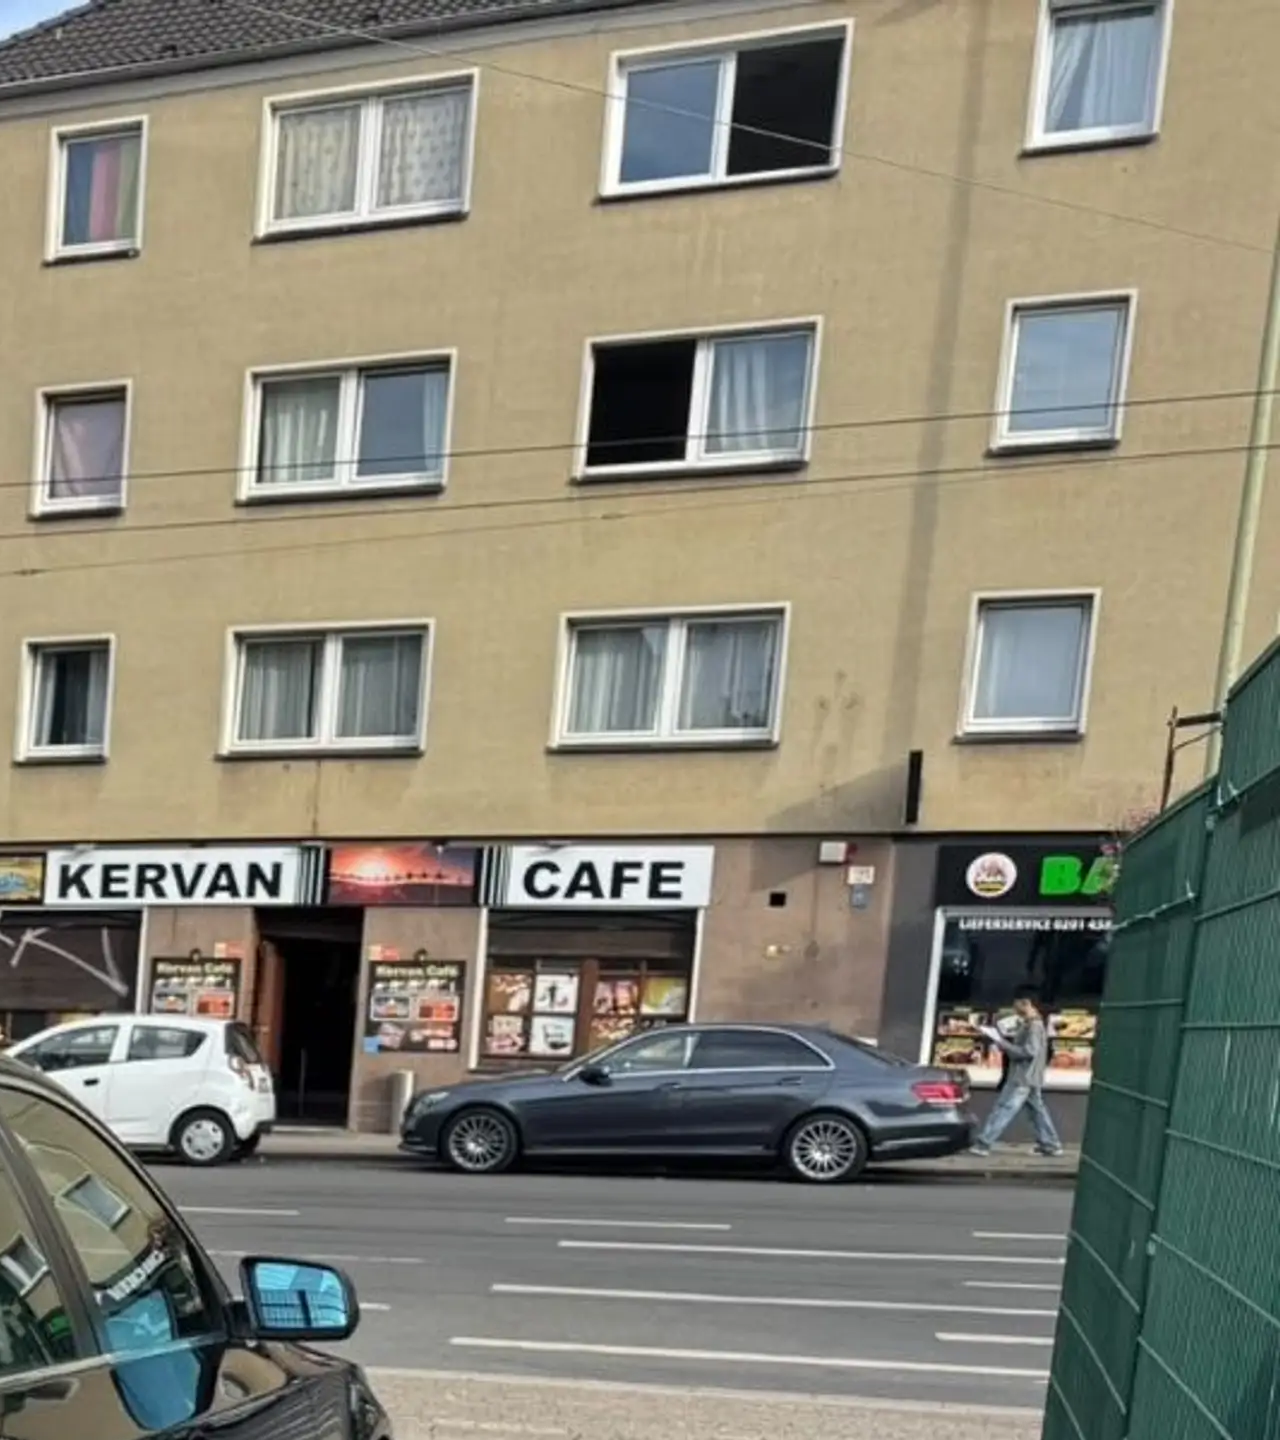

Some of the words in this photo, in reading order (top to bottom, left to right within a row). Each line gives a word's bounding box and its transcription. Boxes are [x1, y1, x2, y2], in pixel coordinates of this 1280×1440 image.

[58, 862, 282, 899] KERVAN
[523, 860, 685, 899] CAFE
[959, 918, 1052, 931] LIEFERSERVICE
